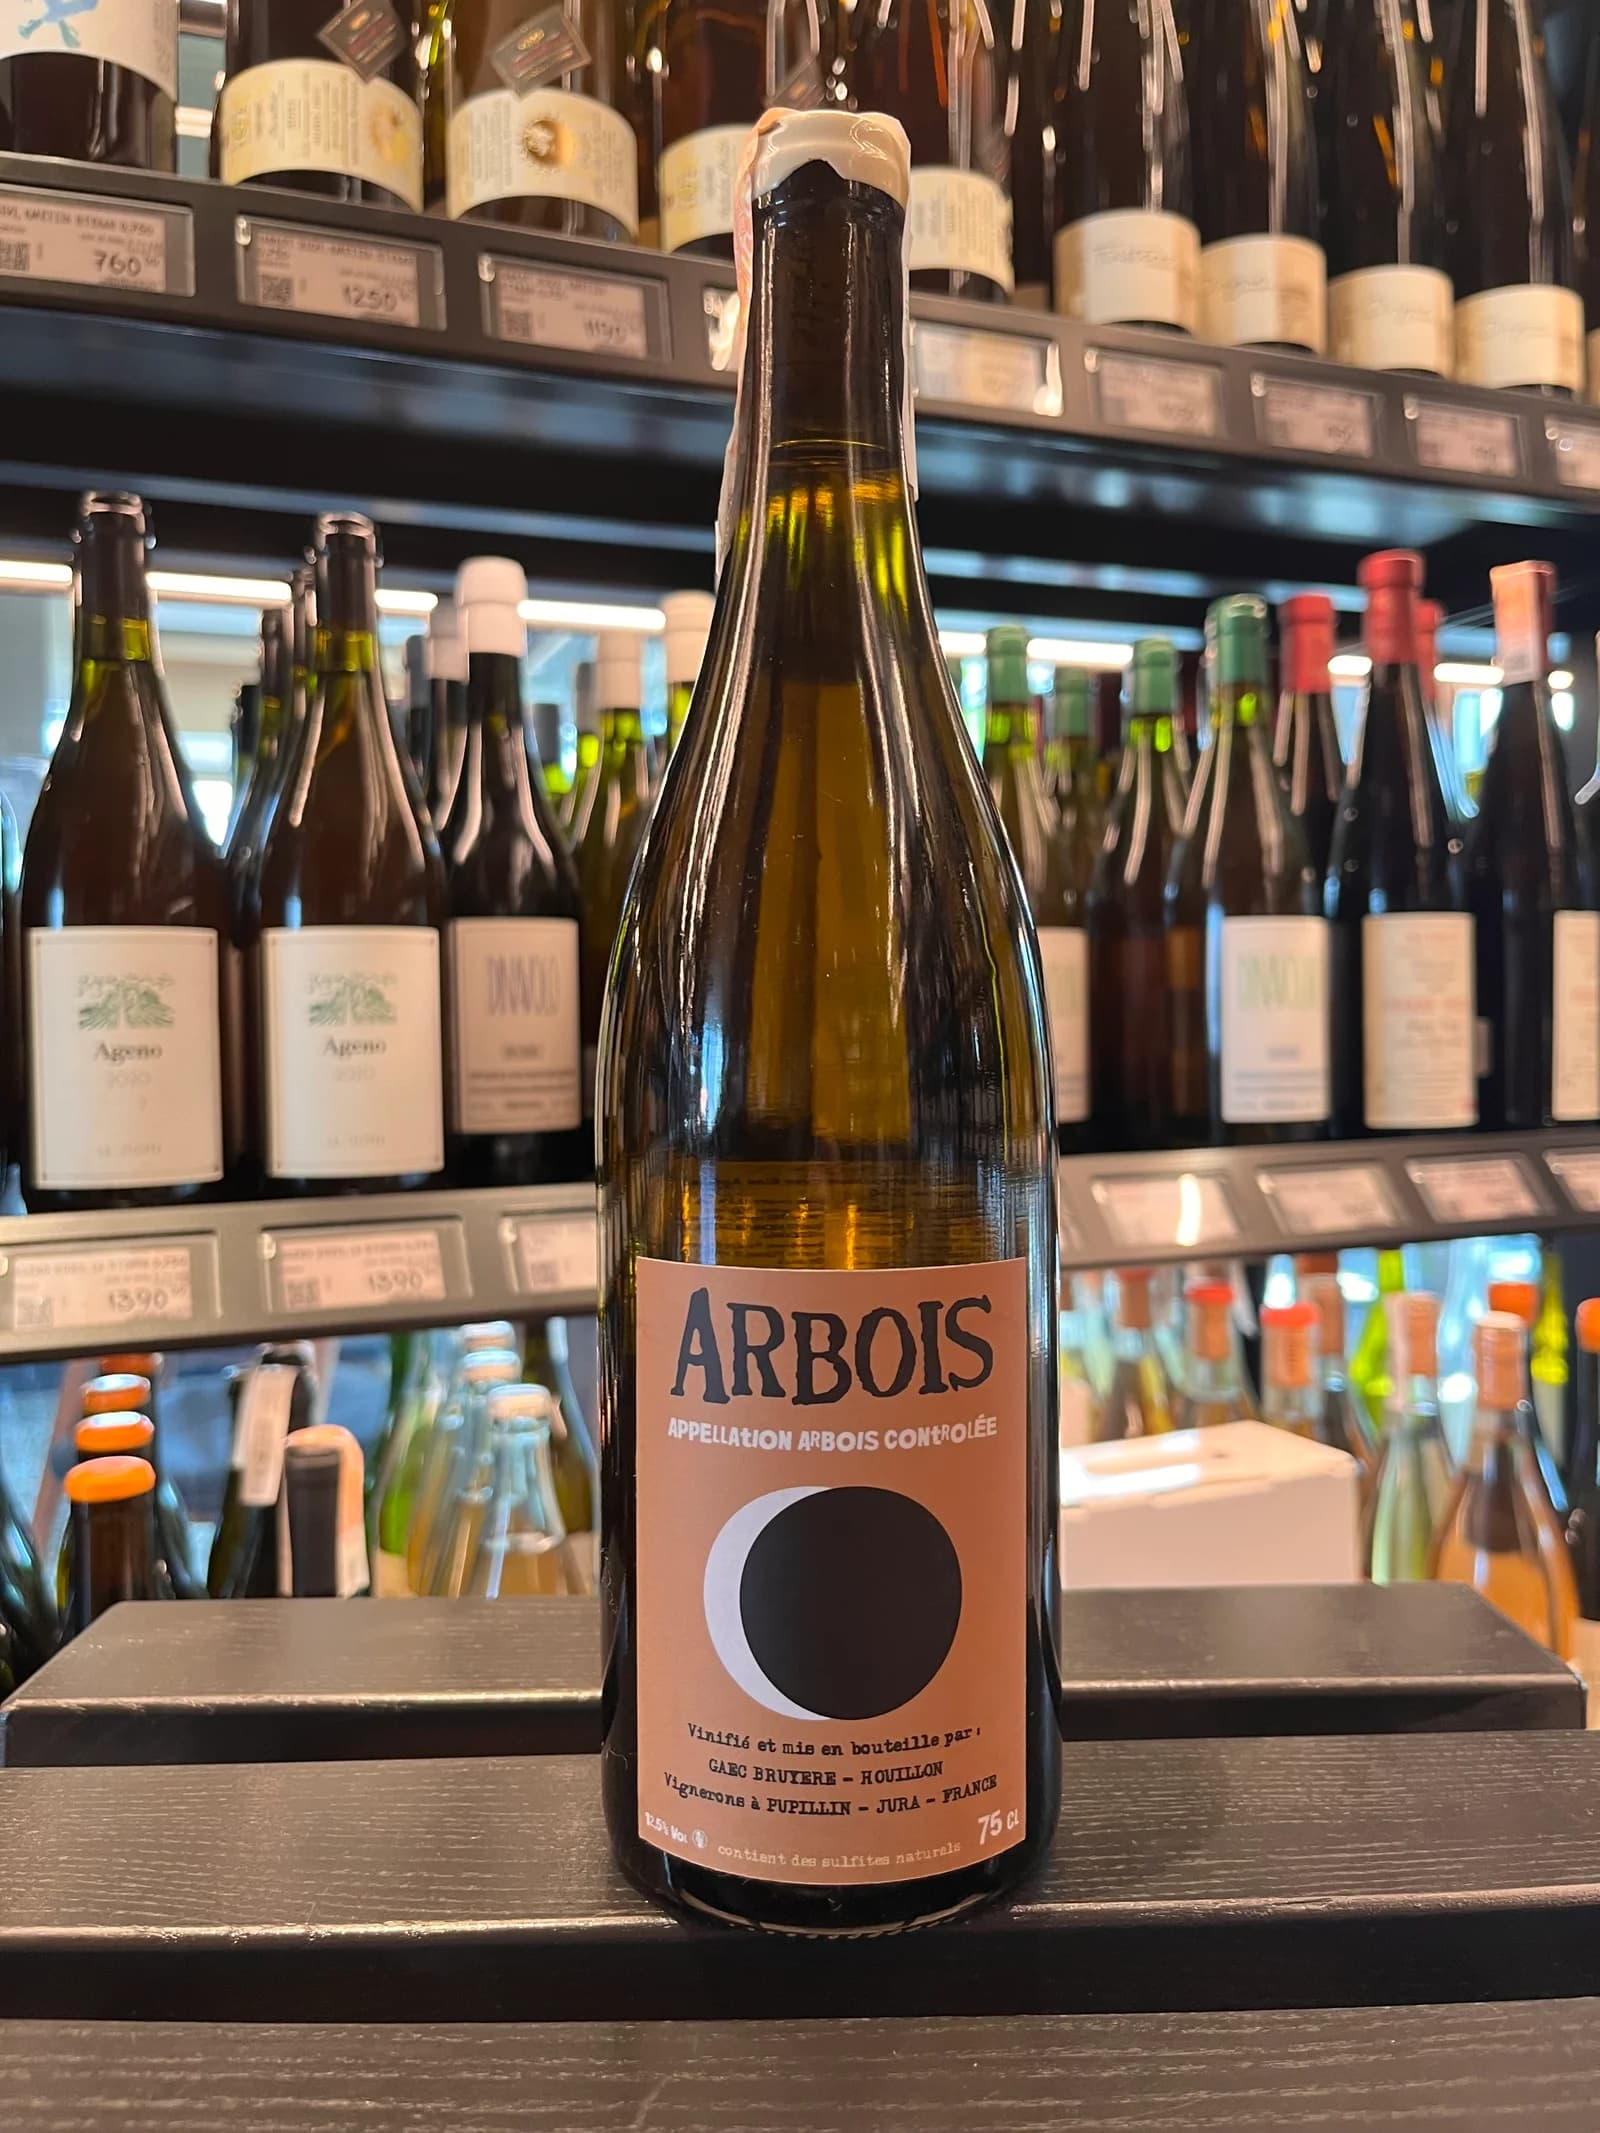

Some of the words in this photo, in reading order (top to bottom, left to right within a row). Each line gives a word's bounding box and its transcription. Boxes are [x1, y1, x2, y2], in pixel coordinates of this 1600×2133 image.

[95, 250, 141, 276] 760
[95, 1041, 163, 1067] Ageno
[323, 1036, 387, 1060] Ageno
[670, 1287, 993, 1405] ARBOIS
[798, 1428, 879, 1452] ARBOIS
[688, 1722, 750, 1749] Vinifié
[758, 1738, 777, 1753] et
[782, 1741, 815, 1755] mis
[821, 1744, 844, 1756] en
[850, 1734, 940, 1755] bouteille
[709, 1758, 747, 1778] GAEC
[753, 1766, 837, 1786] BRUYERE
[861, 1761, 943, 1785] HOUILLON
[664, 1772, 745, 1808] Vignerons
[751, 1796, 761, 1810] à
[767, 1798, 852, 1816] PUPILLIN
[876, 1795, 920, 1814] JURA
[942, 1774, 998, 1804] FRANCE
[978, 1809, 1002, 1845] 75
[718, 1845, 786, 1865] contient
[791, 1854, 817, 1867] des
[822, 1855, 889, 1868] sulfites
